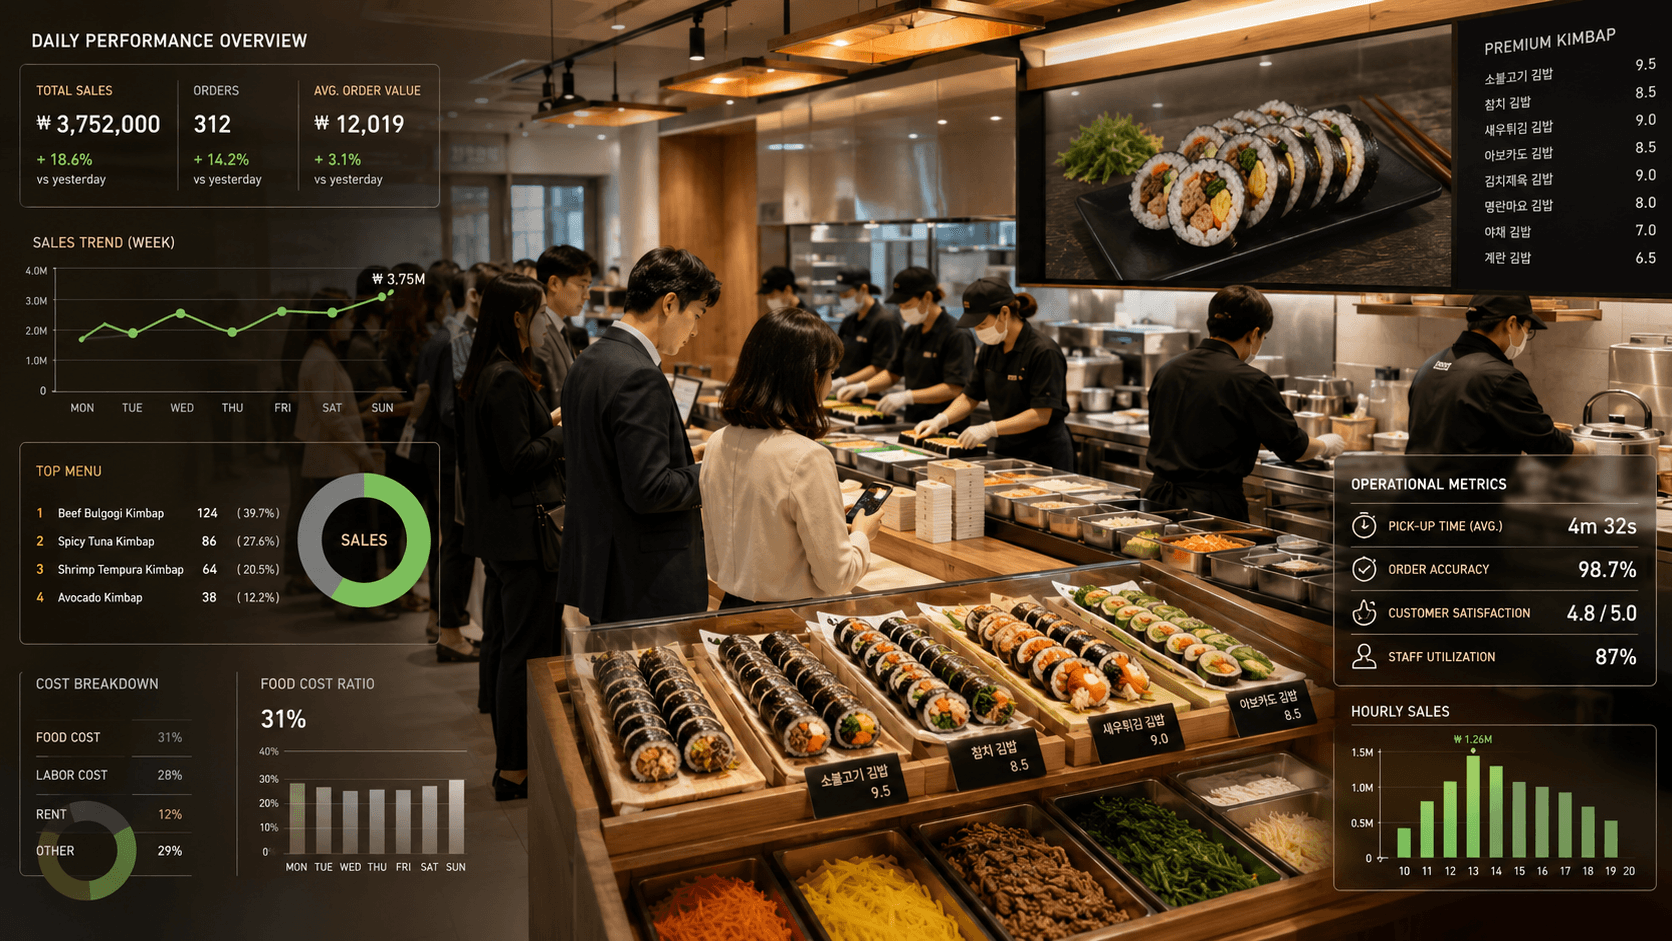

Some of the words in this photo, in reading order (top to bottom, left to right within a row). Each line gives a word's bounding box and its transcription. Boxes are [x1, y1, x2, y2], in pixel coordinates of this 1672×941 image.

[1485, 35, 1551, 55] PREMIUM
[1557, 28, 1616, 47] KIMBAP
[1636, 57, 1656, 71] 9.5
[1531, 67, 1553, 81] 김밥
[1636, 85, 1656, 99] 8.5
[1485, 97, 1505, 111] 참치
[1510, 95, 1531, 110] 김밥
[1636, 112, 1656, 127] 9.0
[1485, 122, 1527, 136] 새우튀김
[1531, 120, 1553, 134] 김밥
[1485, 148, 1528, 162] 아보카도
[1532, 146, 1553, 160] 김밥
[1635, 140, 1656, 154] 8.5
[1485, 174, 1528, 188] 김치제육
[1532, 172, 1553, 186] 김밥
[1636, 167, 1656, 182] 9.0
[1485, 199, 1528, 214] 명란마요
[1531, 198, 1553, 213] 김밥
[1635, 195, 1656, 210] 8.0
[1485, 225, 1506, 239] 야채
[1510, 225, 1531, 239] 김밥
[1636, 223, 1656, 237] 7.0
[1485, 251, 1506, 265] 계란
[1510, 251, 1531, 265] 김밥
[1636, 251, 1656, 265] 6.5
[1239, 693, 1278, 710] 아보카도
[1278, 689, 1298, 704] 김밥
[1284, 708, 1301, 721] 8.5
[1102, 717, 1143, 736] 새우튀김
[1144, 713, 1165, 729] 김밥
[1150, 733, 1169, 746] 9.0
[970, 744, 994, 760] 참치
[995, 740, 1018, 756] 김밥
[866, 764, 888, 780] 김밥
[1010, 758, 1029, 772] 8.5
[871, 785, 891, 799] 9.5
